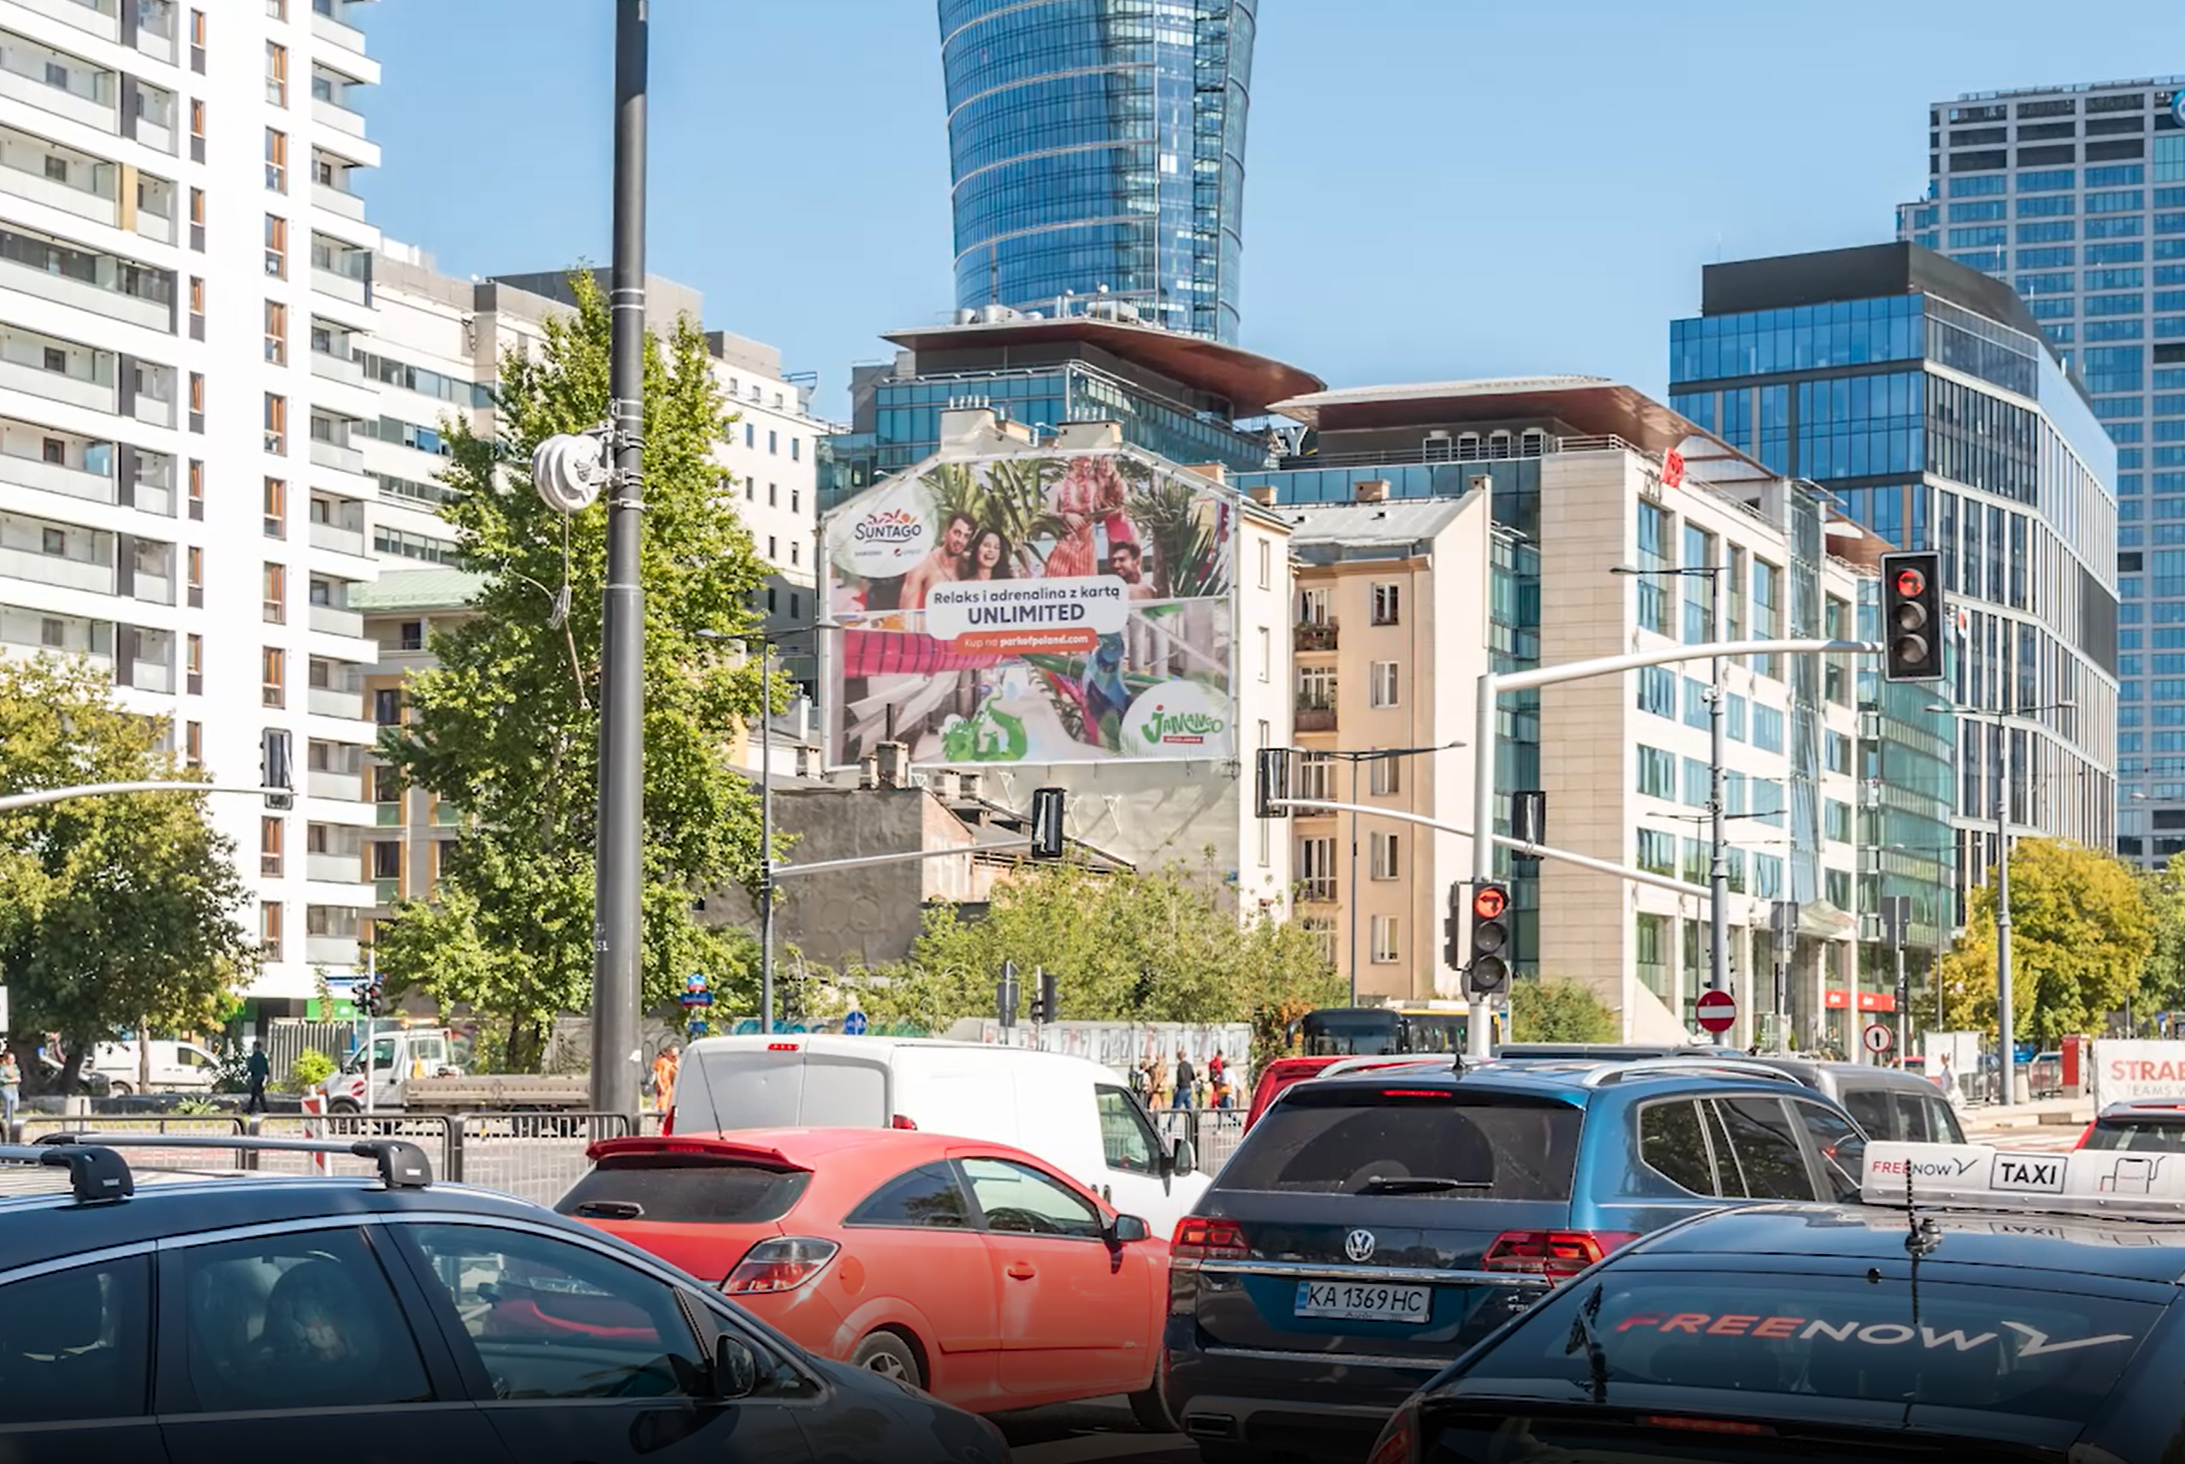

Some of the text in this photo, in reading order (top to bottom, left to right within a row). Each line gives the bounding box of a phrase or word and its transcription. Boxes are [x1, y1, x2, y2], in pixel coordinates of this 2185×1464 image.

[854, 523, 922, 540] SUNTAGO
[934, 585, 1120, 604] Relaks i adrenalina z kartą
[968, 603, 1085, 625] UNLIMITED
[964, 638, 983, 649] Kup
[1000, 634, 1089, 649] parkofpoland.com
[2001, 1163, 2057, 1185] TAXI
[1307, 1286, 1423, 1312] KA 1369 HC
